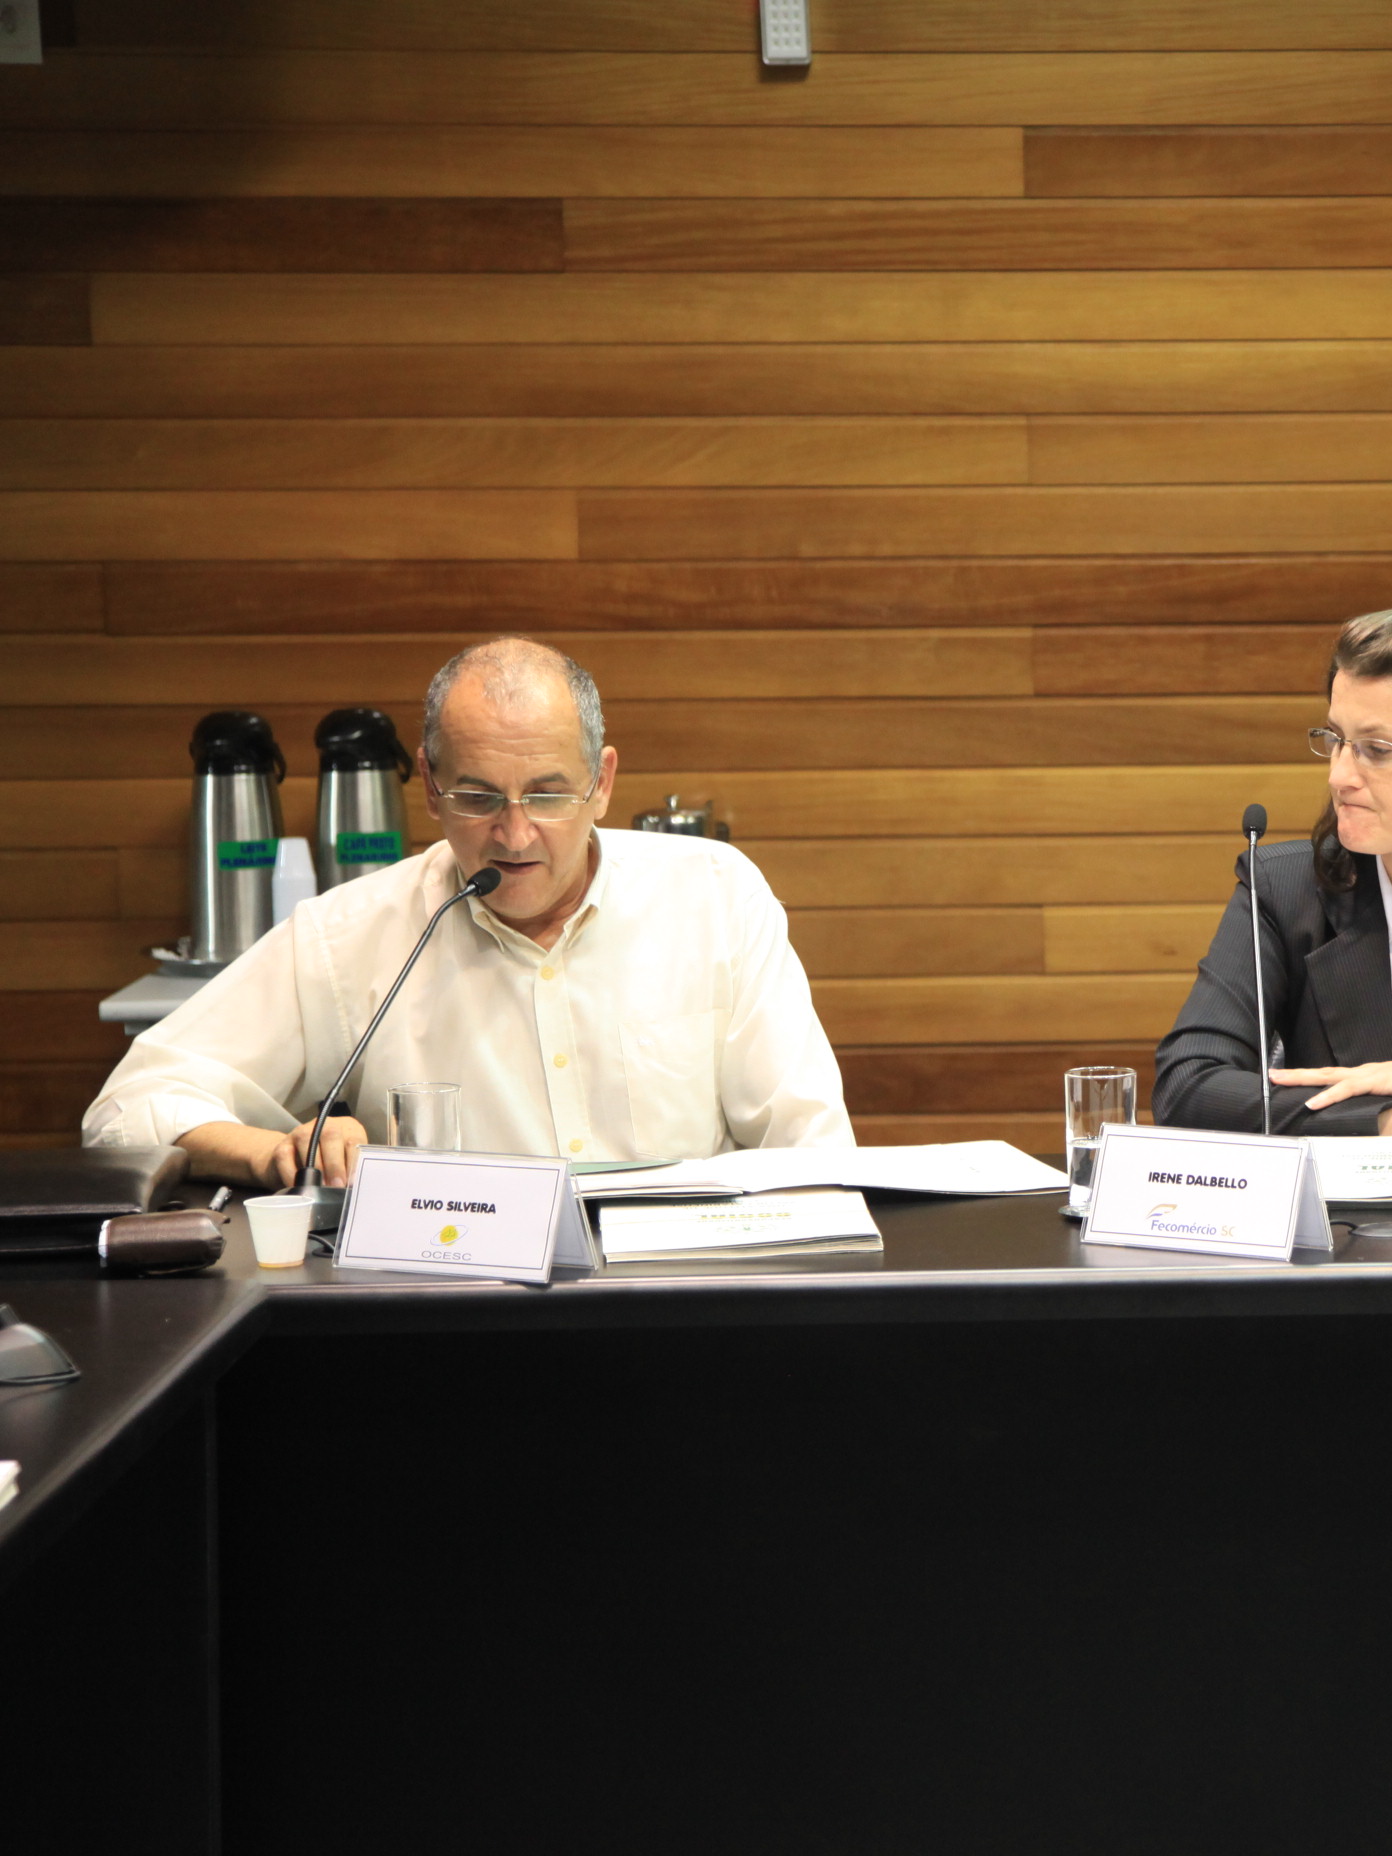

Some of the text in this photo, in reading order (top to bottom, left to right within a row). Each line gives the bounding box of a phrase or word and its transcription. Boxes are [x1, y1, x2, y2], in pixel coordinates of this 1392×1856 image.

[1147, 1171, 1248, 1190] IRENE DALBELLO
[410, 1198, 497, 1214] ELVIO SILVEIRA
[1150, 1219, 1236, 1237] Fecomércio SC
[420, 1250, 473, 1262] OCESC
